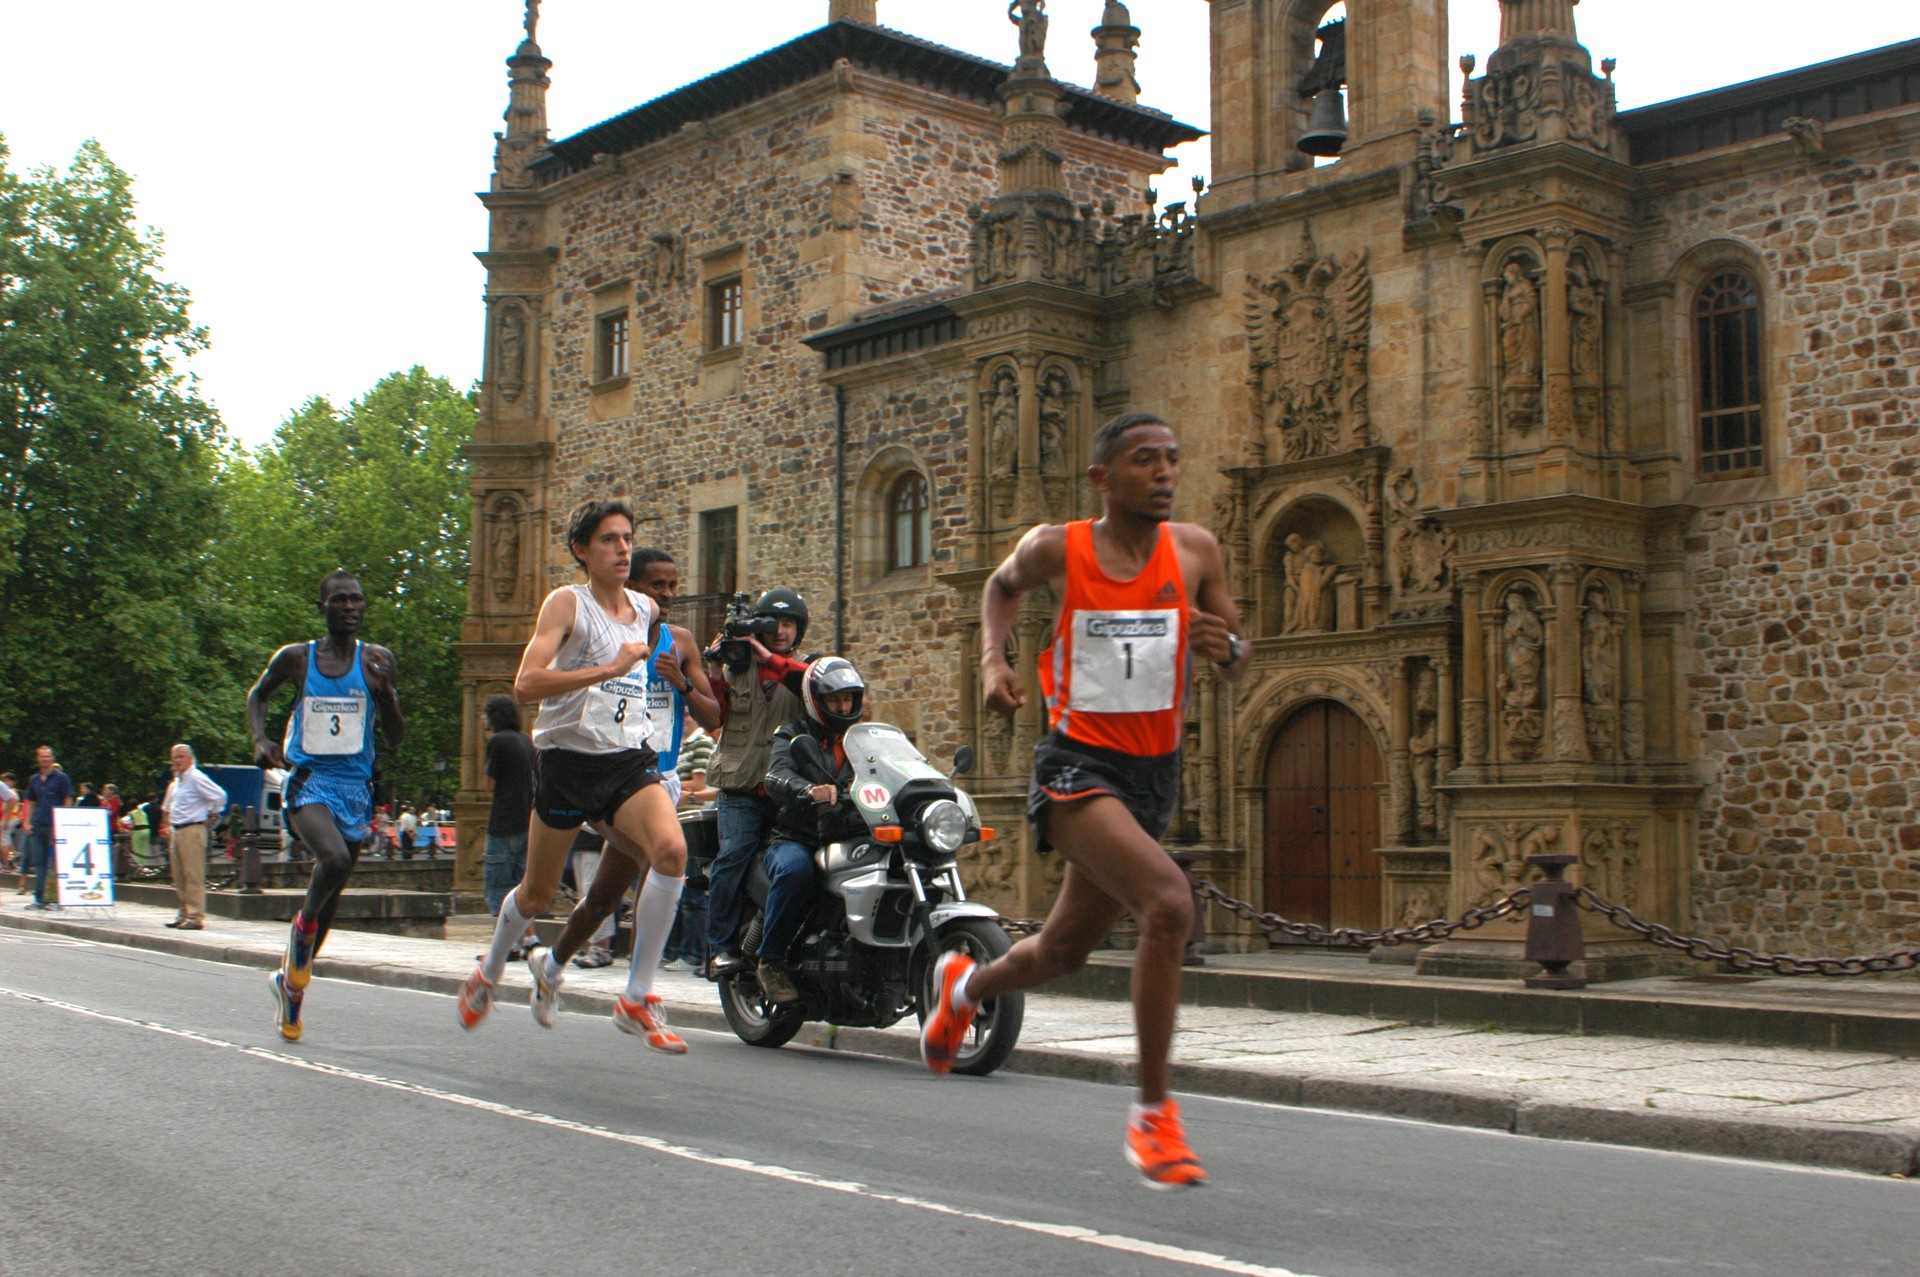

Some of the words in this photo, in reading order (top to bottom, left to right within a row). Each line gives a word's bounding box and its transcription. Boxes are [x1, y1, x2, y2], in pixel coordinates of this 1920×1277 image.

[1088, 618, 1168, 638] Gipuzkoa
[1123, 642, 1133, 680] 1
[313, 702, 359, 714] Gipuzkoa
[614, 698, 627, 723] 8
[330, 714, 341, 737] 3
[863, 788, 886, 804] M
[72, 842, 95, 876] 4
